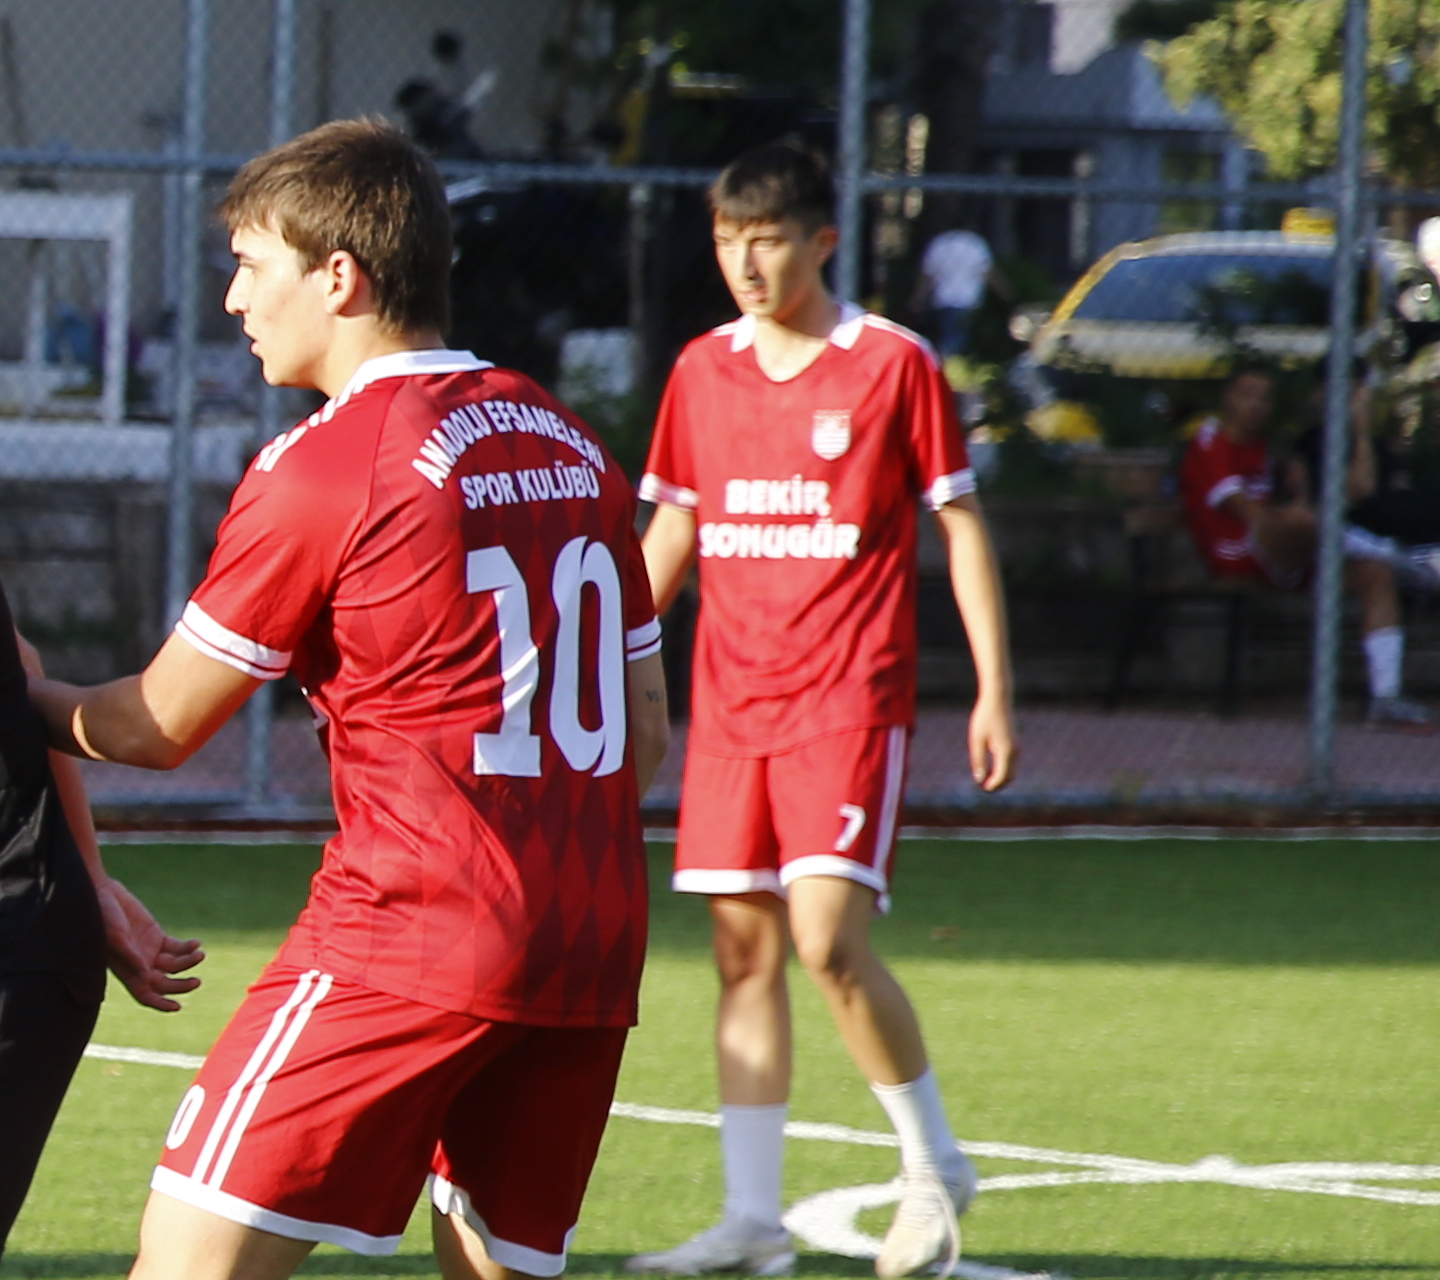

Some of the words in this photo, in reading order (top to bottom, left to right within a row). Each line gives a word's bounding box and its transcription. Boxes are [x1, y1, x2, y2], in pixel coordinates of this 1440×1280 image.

[411, 403, 492, 490] ANADOLU
[481, 400, 606, 474] EFSANELERİ
[460, 471, 519, 510] SPOR
[515, 460, 601, 502] KULÜBÜ
[725, 473, 832, 517] BEKİR
[467, 535, 627, 778] 10
[834, 802, 867, 852] 7
[165, 1083, 206, 1151] 0
